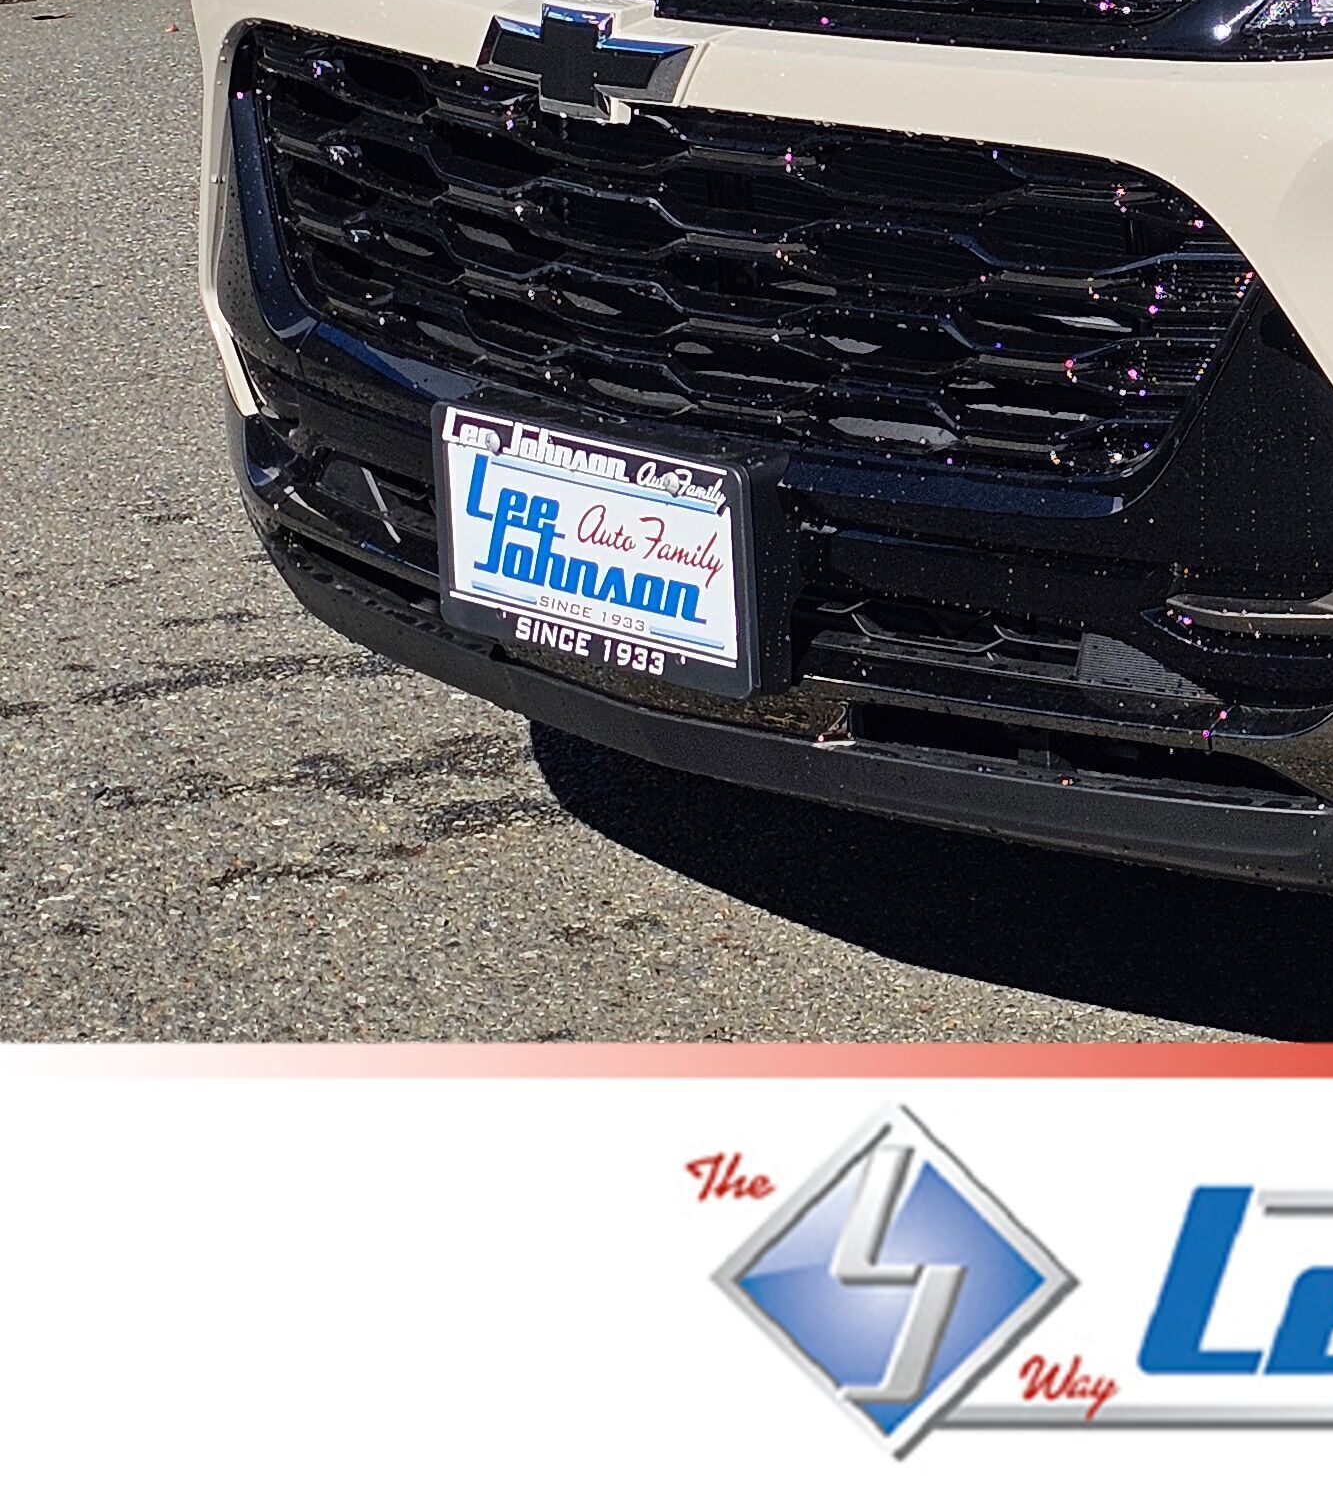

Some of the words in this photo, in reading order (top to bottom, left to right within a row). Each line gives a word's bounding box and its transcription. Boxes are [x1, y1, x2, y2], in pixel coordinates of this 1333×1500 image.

[502, 421, 630, 483] Johnson
[636, 462, 676, 491] Aut
[674, 468, 726, 515] Family
[465, 453, 566, 539] Lee
[576, 504, 637, 553] Auto
[640, 516, 724, 588] Family
[473, 521, 707, 625] Johnson
[538, 594, 592, 619] SINCE
[600, 610, 646, 633] 1933
[514, 617, 592, 657] SINCE
[603, 639, 666, 676] 1933
